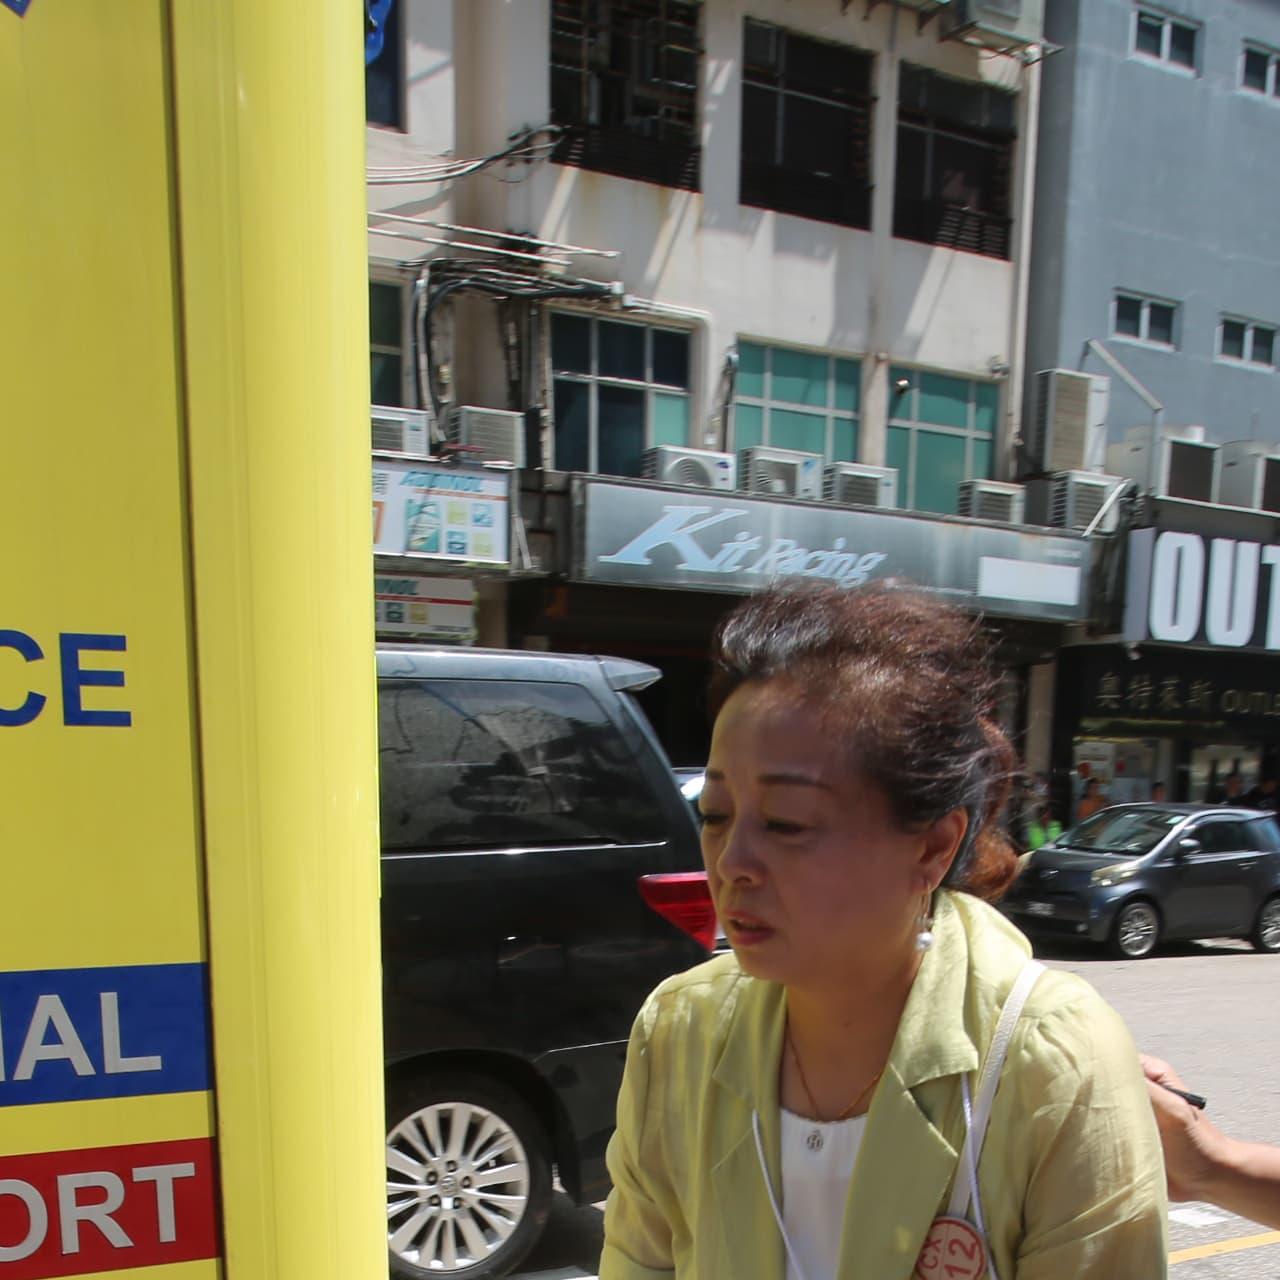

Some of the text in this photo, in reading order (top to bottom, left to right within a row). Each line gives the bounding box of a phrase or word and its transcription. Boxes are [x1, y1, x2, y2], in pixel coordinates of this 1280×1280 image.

[598, 505, 888, 589] Kit Racing
[944, 1239, 977, 1278] 12
